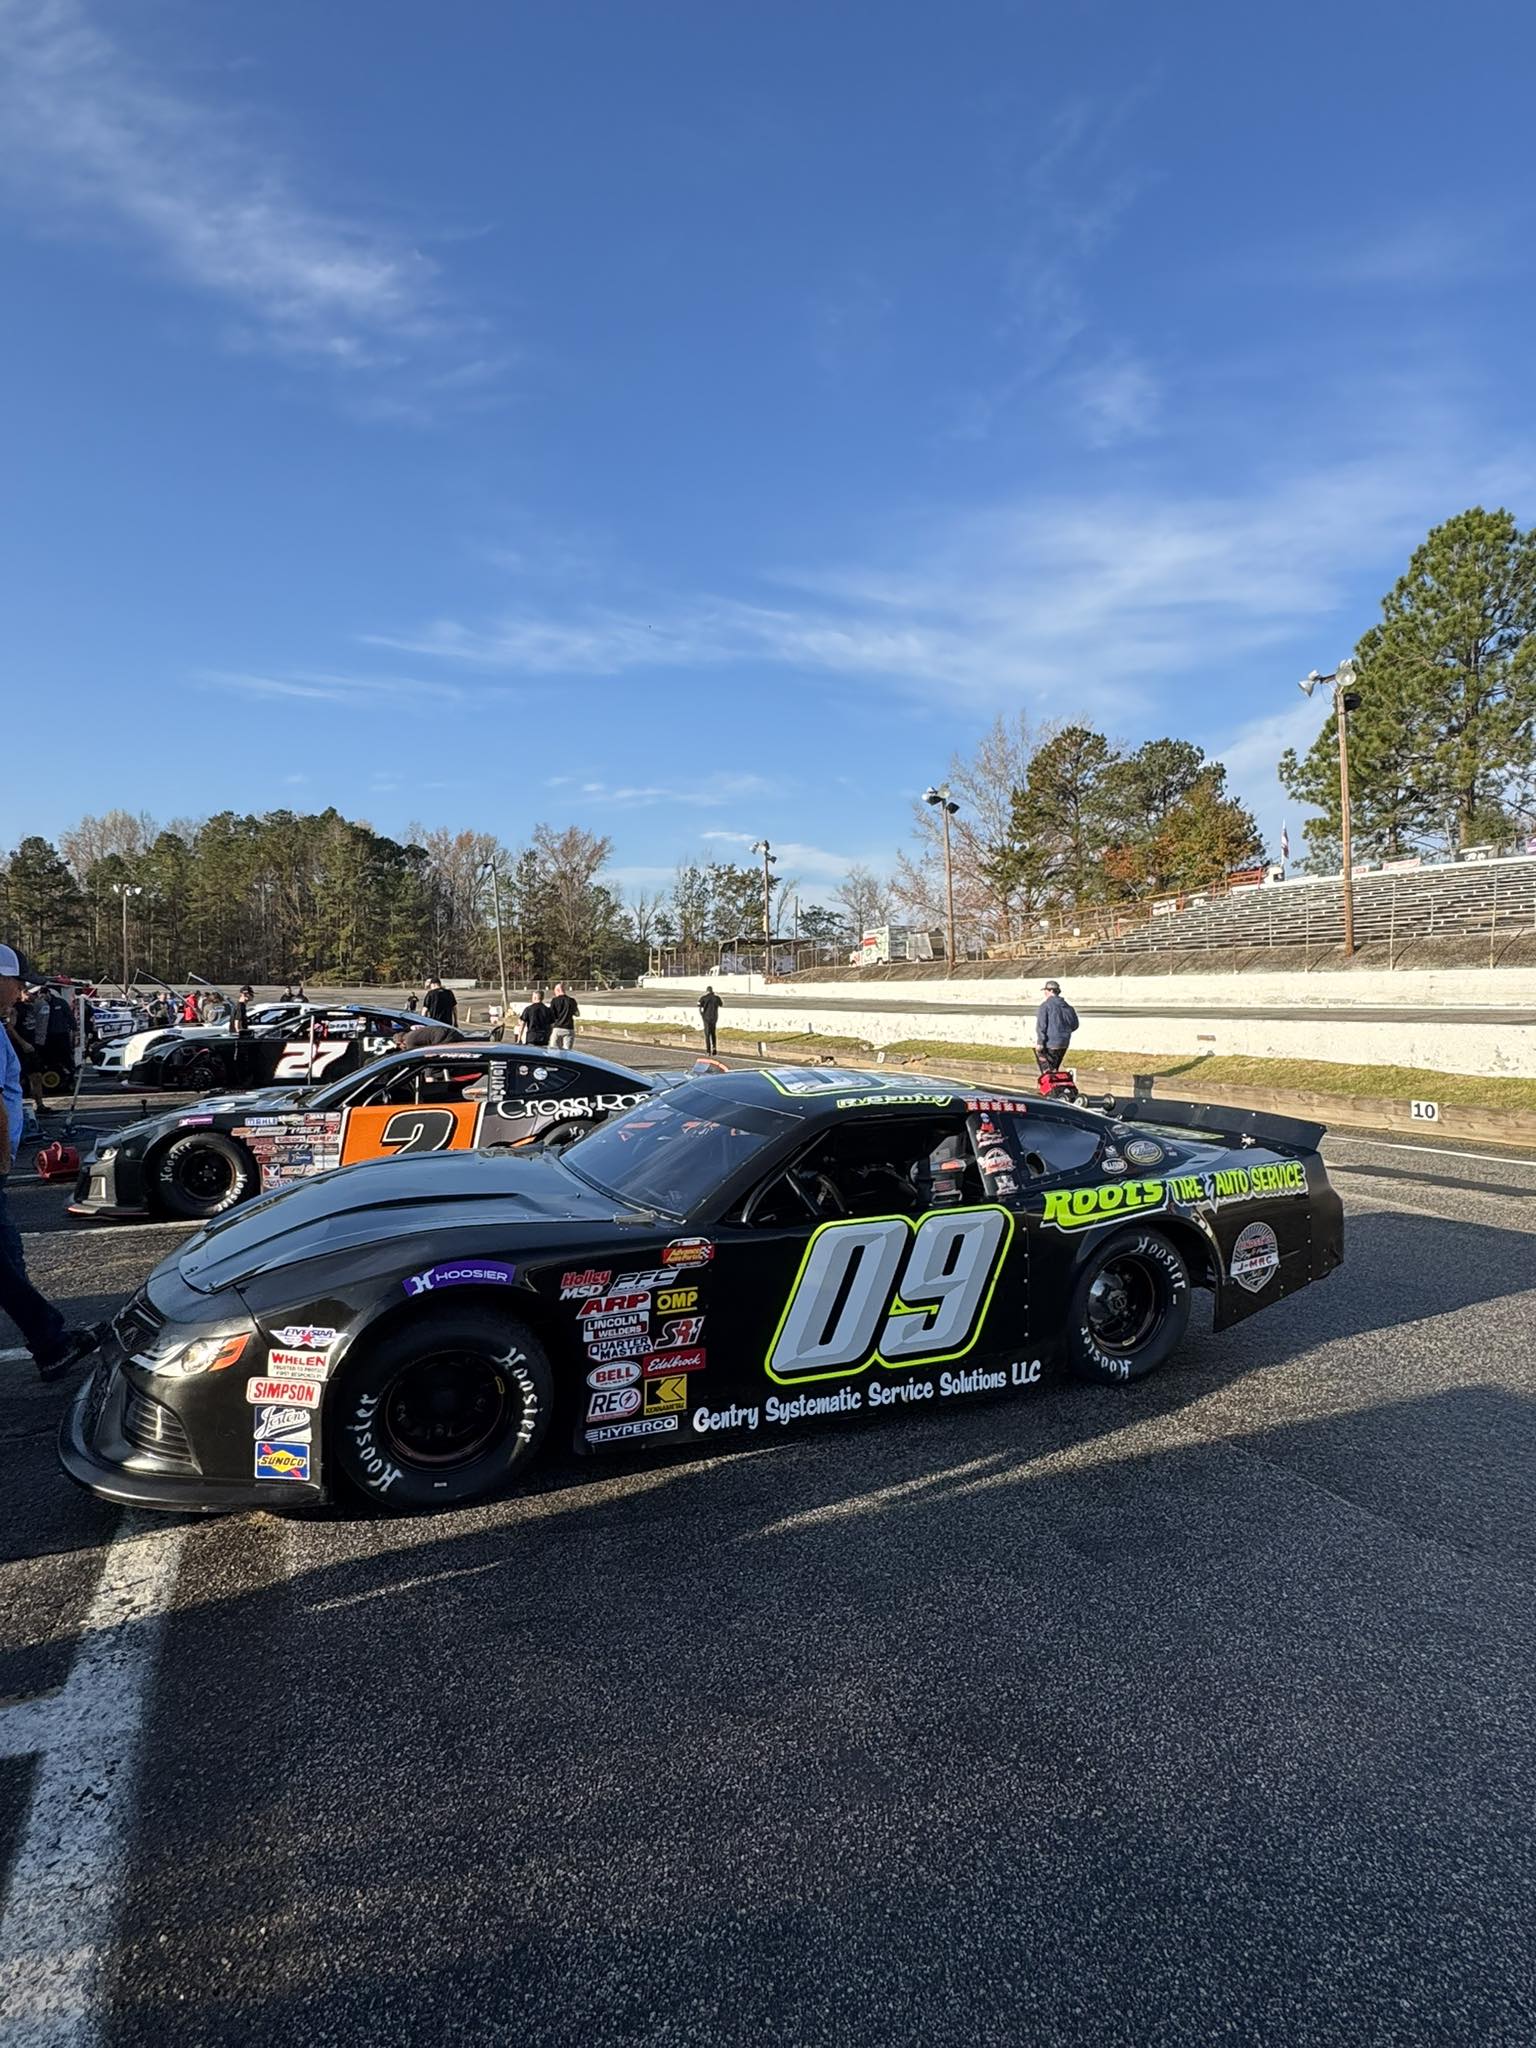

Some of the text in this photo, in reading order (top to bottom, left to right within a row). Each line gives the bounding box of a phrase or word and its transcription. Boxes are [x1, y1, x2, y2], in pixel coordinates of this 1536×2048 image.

[274, 1041, 351, 1078] 27
[497, 1097, 592, 1120] Cross
[1414, 1103, 1436, 1119] 10
[381, 1108, 455, 1155] 2
[160, 1142, 191, 1183] Hoosier
[1167, 1179, 1204, 1200] TIRE
[1215, 1169, 1249, 1195] AUTO
[1250, 1162, 1305, 1192] SERVICE
[1131, 1236, 1186, 1289] Hoosier
[1237, 1256, 1272, 1271] J-MAC
[436, 1269, 508, 1282] HOOSIER
[561, 1270, 612, 1288] Holley
[613, 1269, 679, 1288] PFC
[560, 1286, 604, 1300] MSD
[770, 1207, 1007, 1373] 09
[579, 1292, 650, 1316] ARP
[657, 1291, 698, 1310] OMP
[587, 1315, 638, 1330] LINCOLN
[598, 1325, 642, 1338] WELDERS
[589, 1337, 649, 1356] QUARTER
[600, 1344, 652, 1360] MASTER
[1080, 1326, 1131, 1379] Hoosier
[271, 1352, 327, 1366] WHELEN
[648, 1354, 701, 1372] Edelbrock
[595, 1367, 634, 1384] BELL
[253, 1382, 315, 1402] SIMPSON
[491, 1347, 543, 1443] Hoosier
[692, 1360, 1041, 1433] Gentry Systematic Service Solutions LLC
[256, 1407, 308, 1438] Jostens
[600, 1418, 675, 1438] HYPERCO
[346, 1394, 403, 1491] Hoosier
[260, 1456, 305, 1466] SUNOCO
